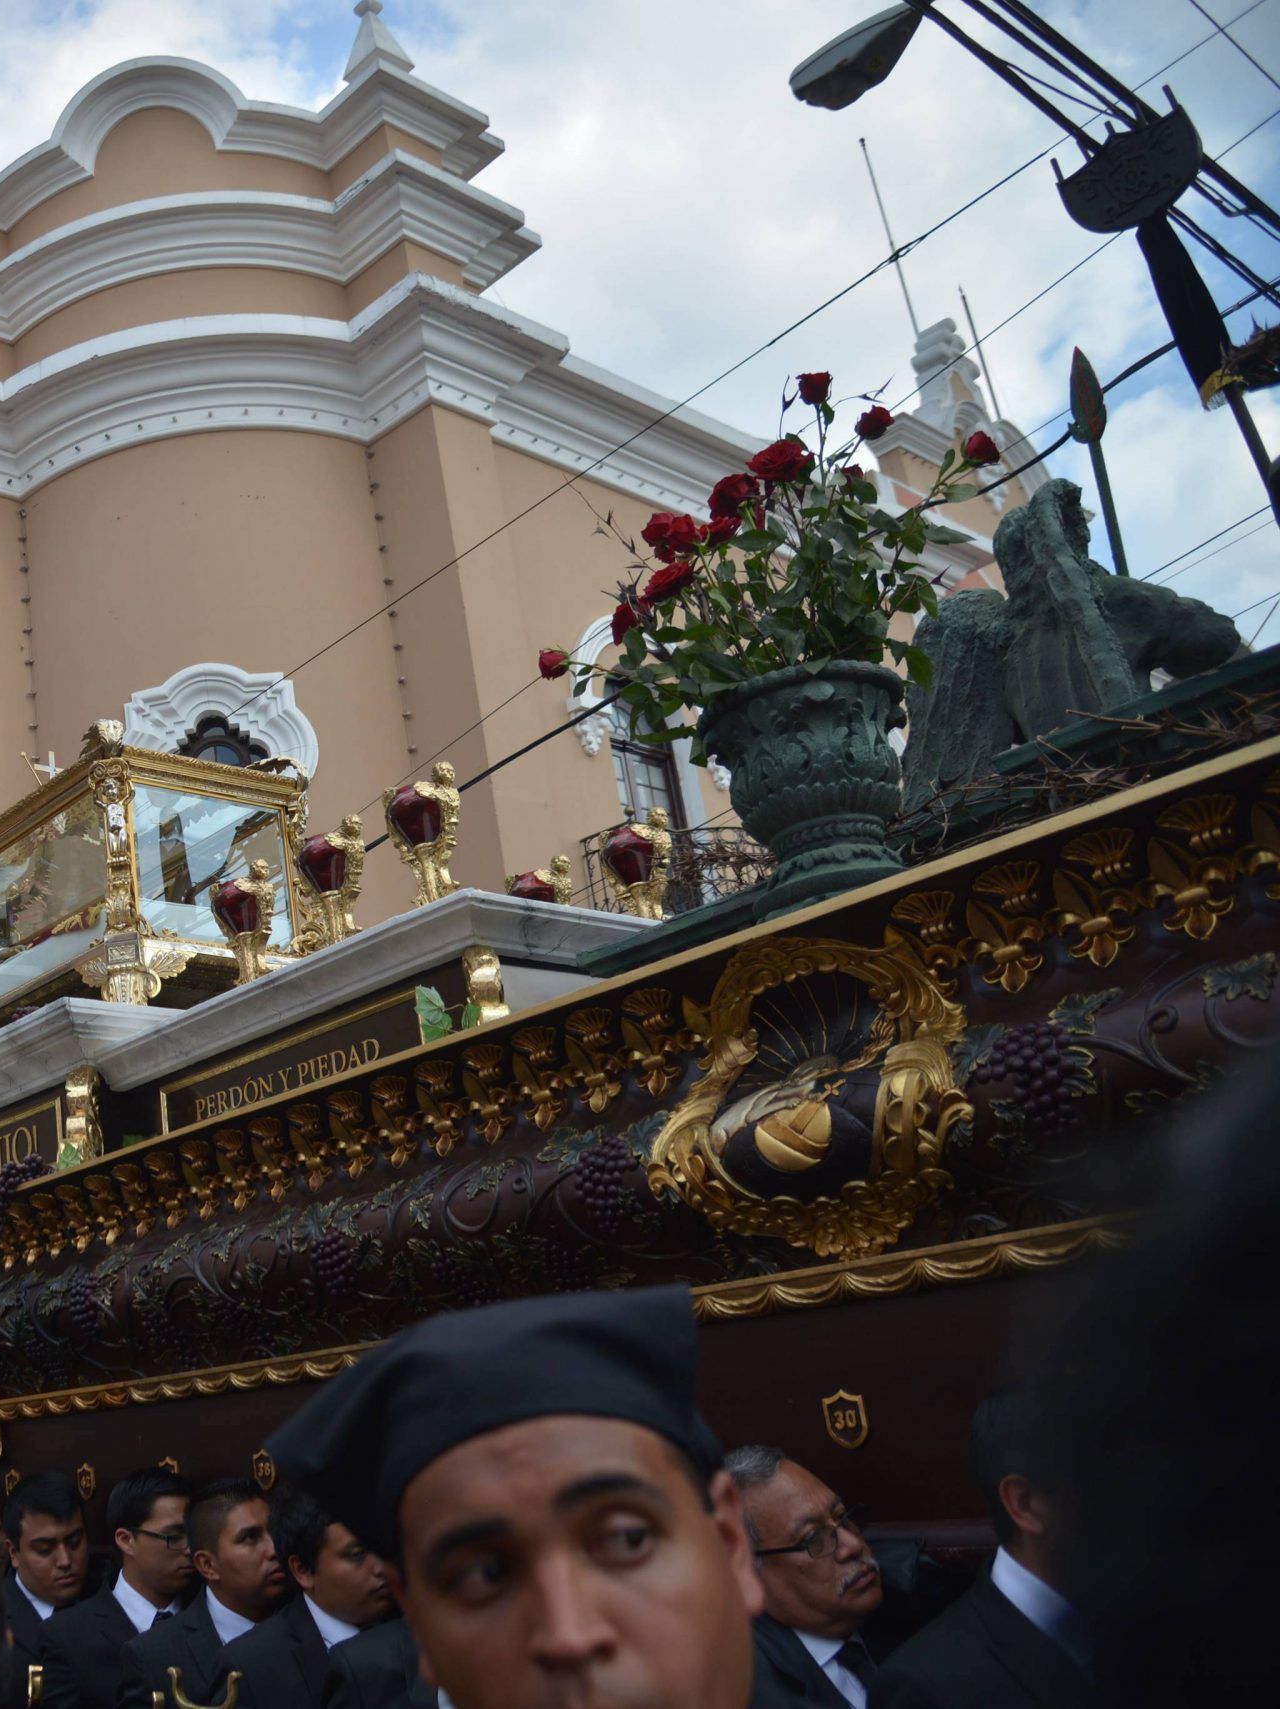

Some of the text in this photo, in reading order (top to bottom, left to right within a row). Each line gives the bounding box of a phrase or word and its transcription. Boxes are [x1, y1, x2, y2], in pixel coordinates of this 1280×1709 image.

[194, 1038, 380, 1122] PERDÓN Y PIEDAD
[834, 1409, 856, 1429] 30
